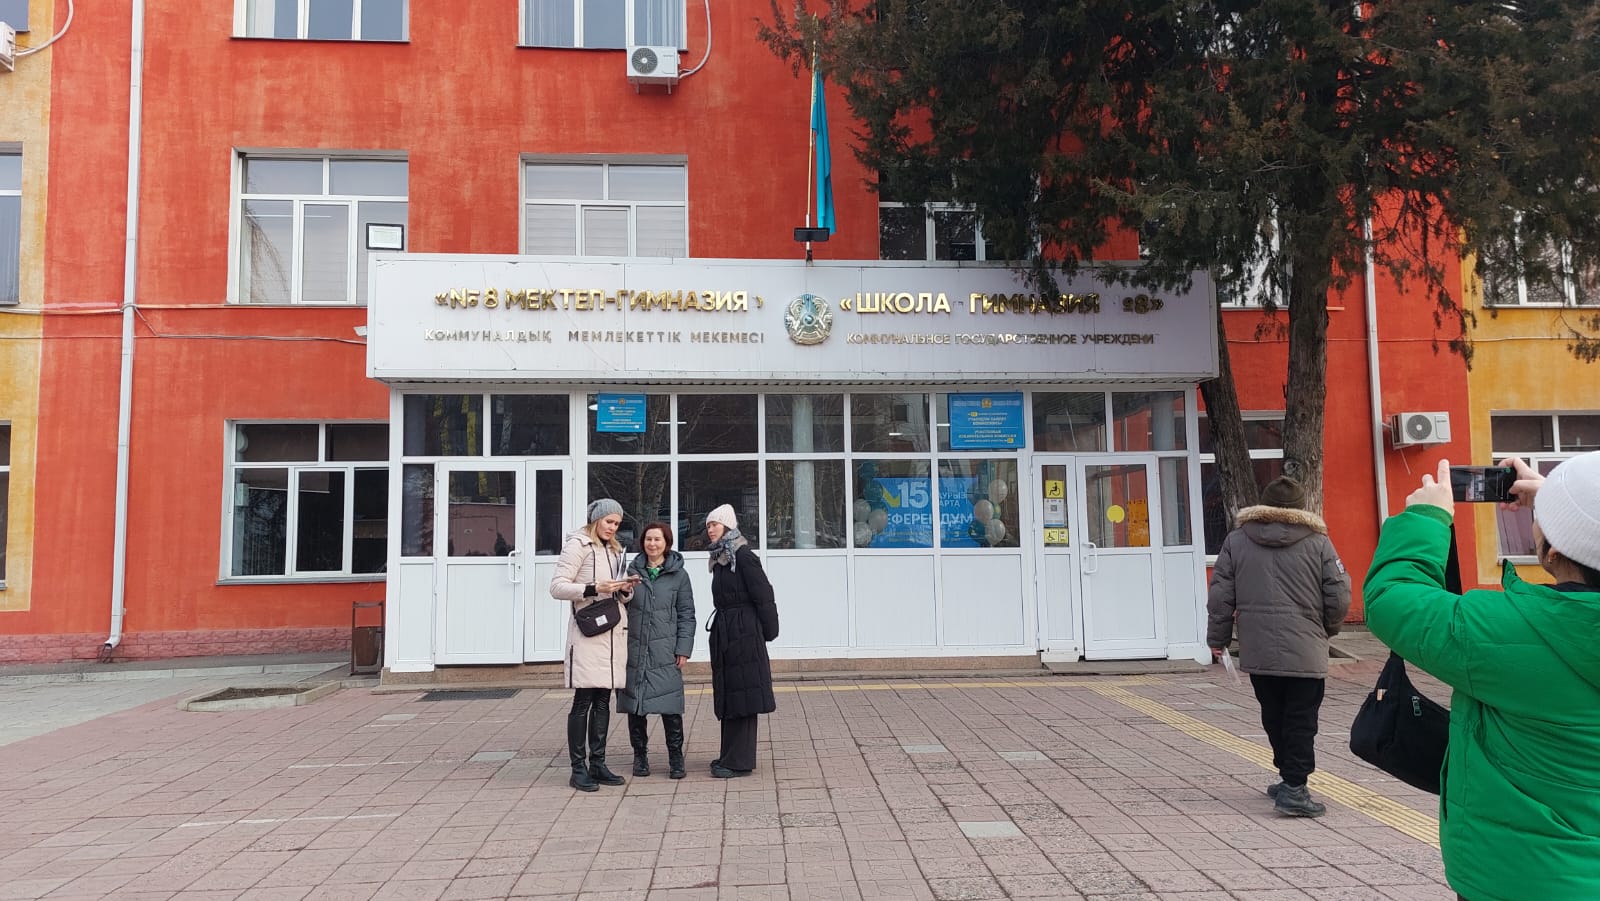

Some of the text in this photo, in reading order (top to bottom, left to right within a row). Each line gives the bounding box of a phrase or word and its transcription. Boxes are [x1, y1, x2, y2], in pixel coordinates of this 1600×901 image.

[568, 330, 681, 343] МЕМЛЕКЕТТІК
[690, 331, 765, 344] МЕКЕМЕСІ
[897, 481, 929, 509] 15
[939, 500, 961, 508] АРТА
[887, 513, 974, 525] ЕФЕРЕДУМ
